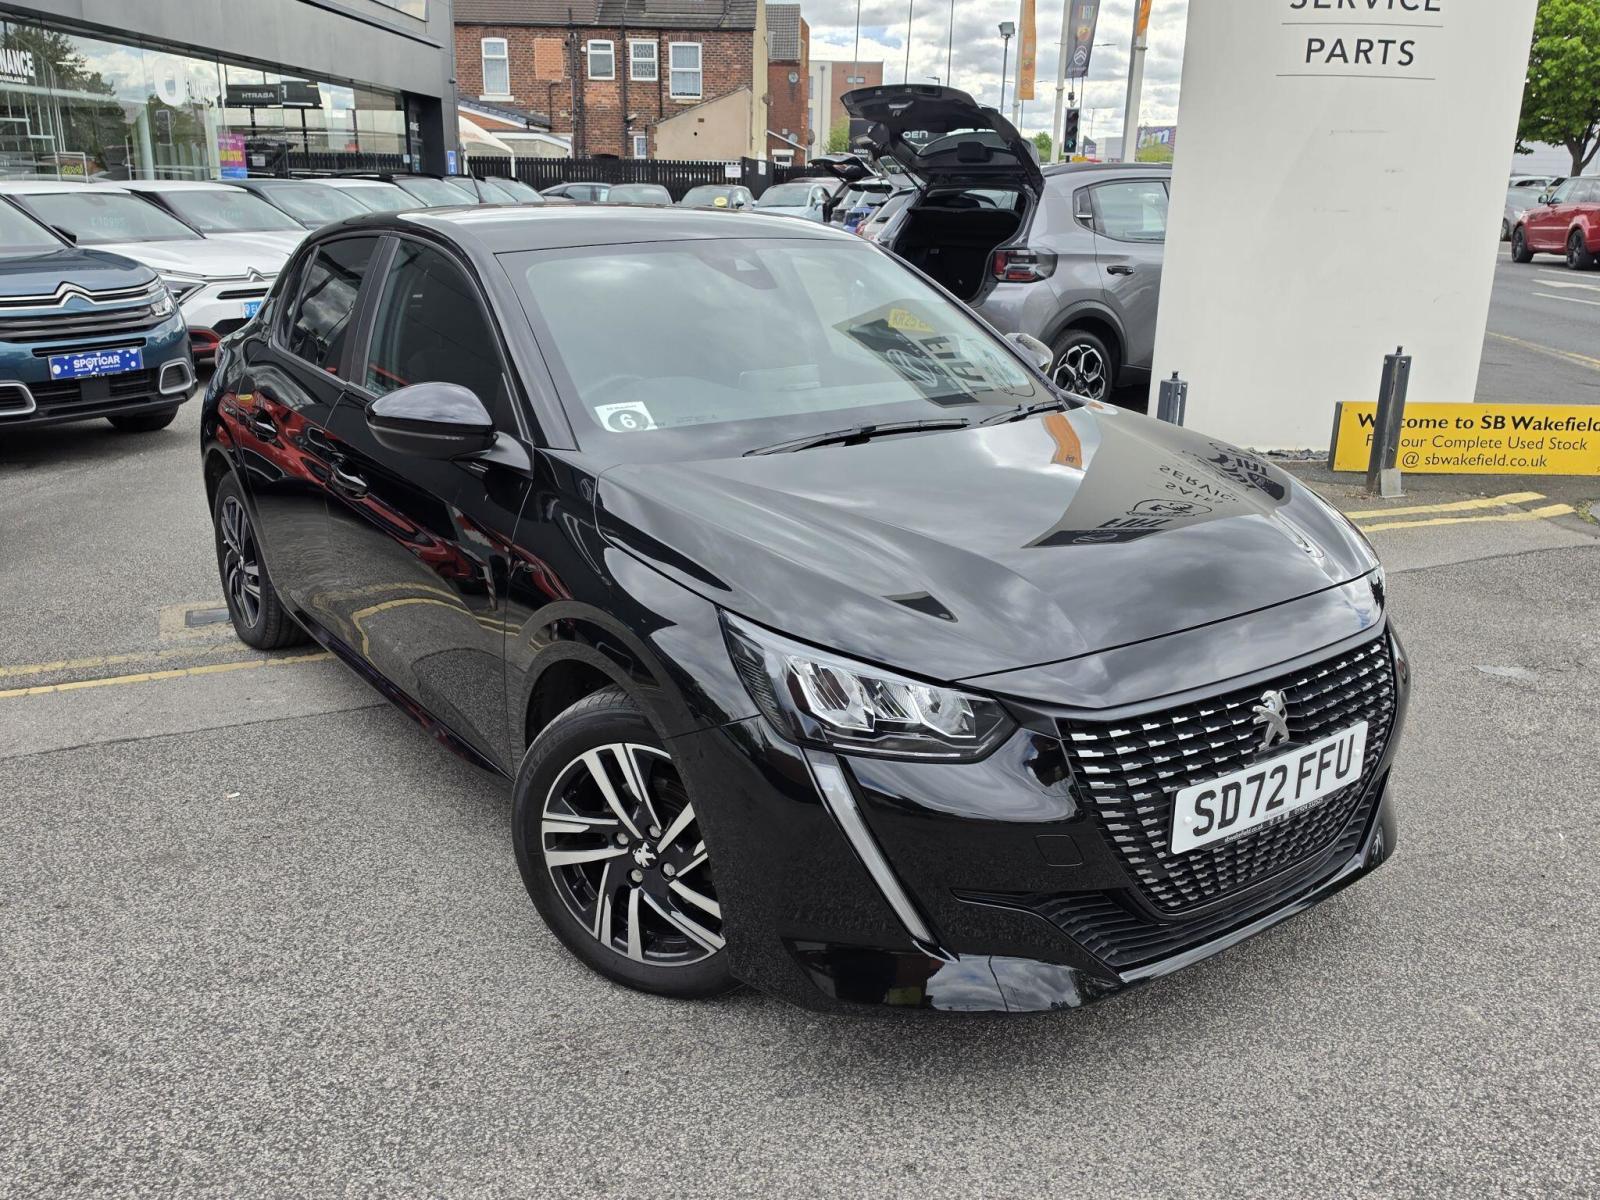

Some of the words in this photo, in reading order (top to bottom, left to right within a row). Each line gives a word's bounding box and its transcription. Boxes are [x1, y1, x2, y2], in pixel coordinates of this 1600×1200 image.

[1305, 38, 1415, 66] PARTS
[620, 413, 637, 429] 6
[1358, 413, 1449, 429] Wcome
[1455, 416, 1474, 430] to
[1481, 415, 1506, 430] SB
[1401, 438, 1428, 448] our
[1432, 434, 1503, 452] Complete
[1508, 435, 1545, 450] Used
[1548, 436, 1590, 450] Stock
[1401, 451, 1420, 468] @
[1424, 453, 1548, 468] sbwakefield.co.uk
[1192, 765, 1288, 837] SD72
[1295, 734, 1355, 800] FFU
